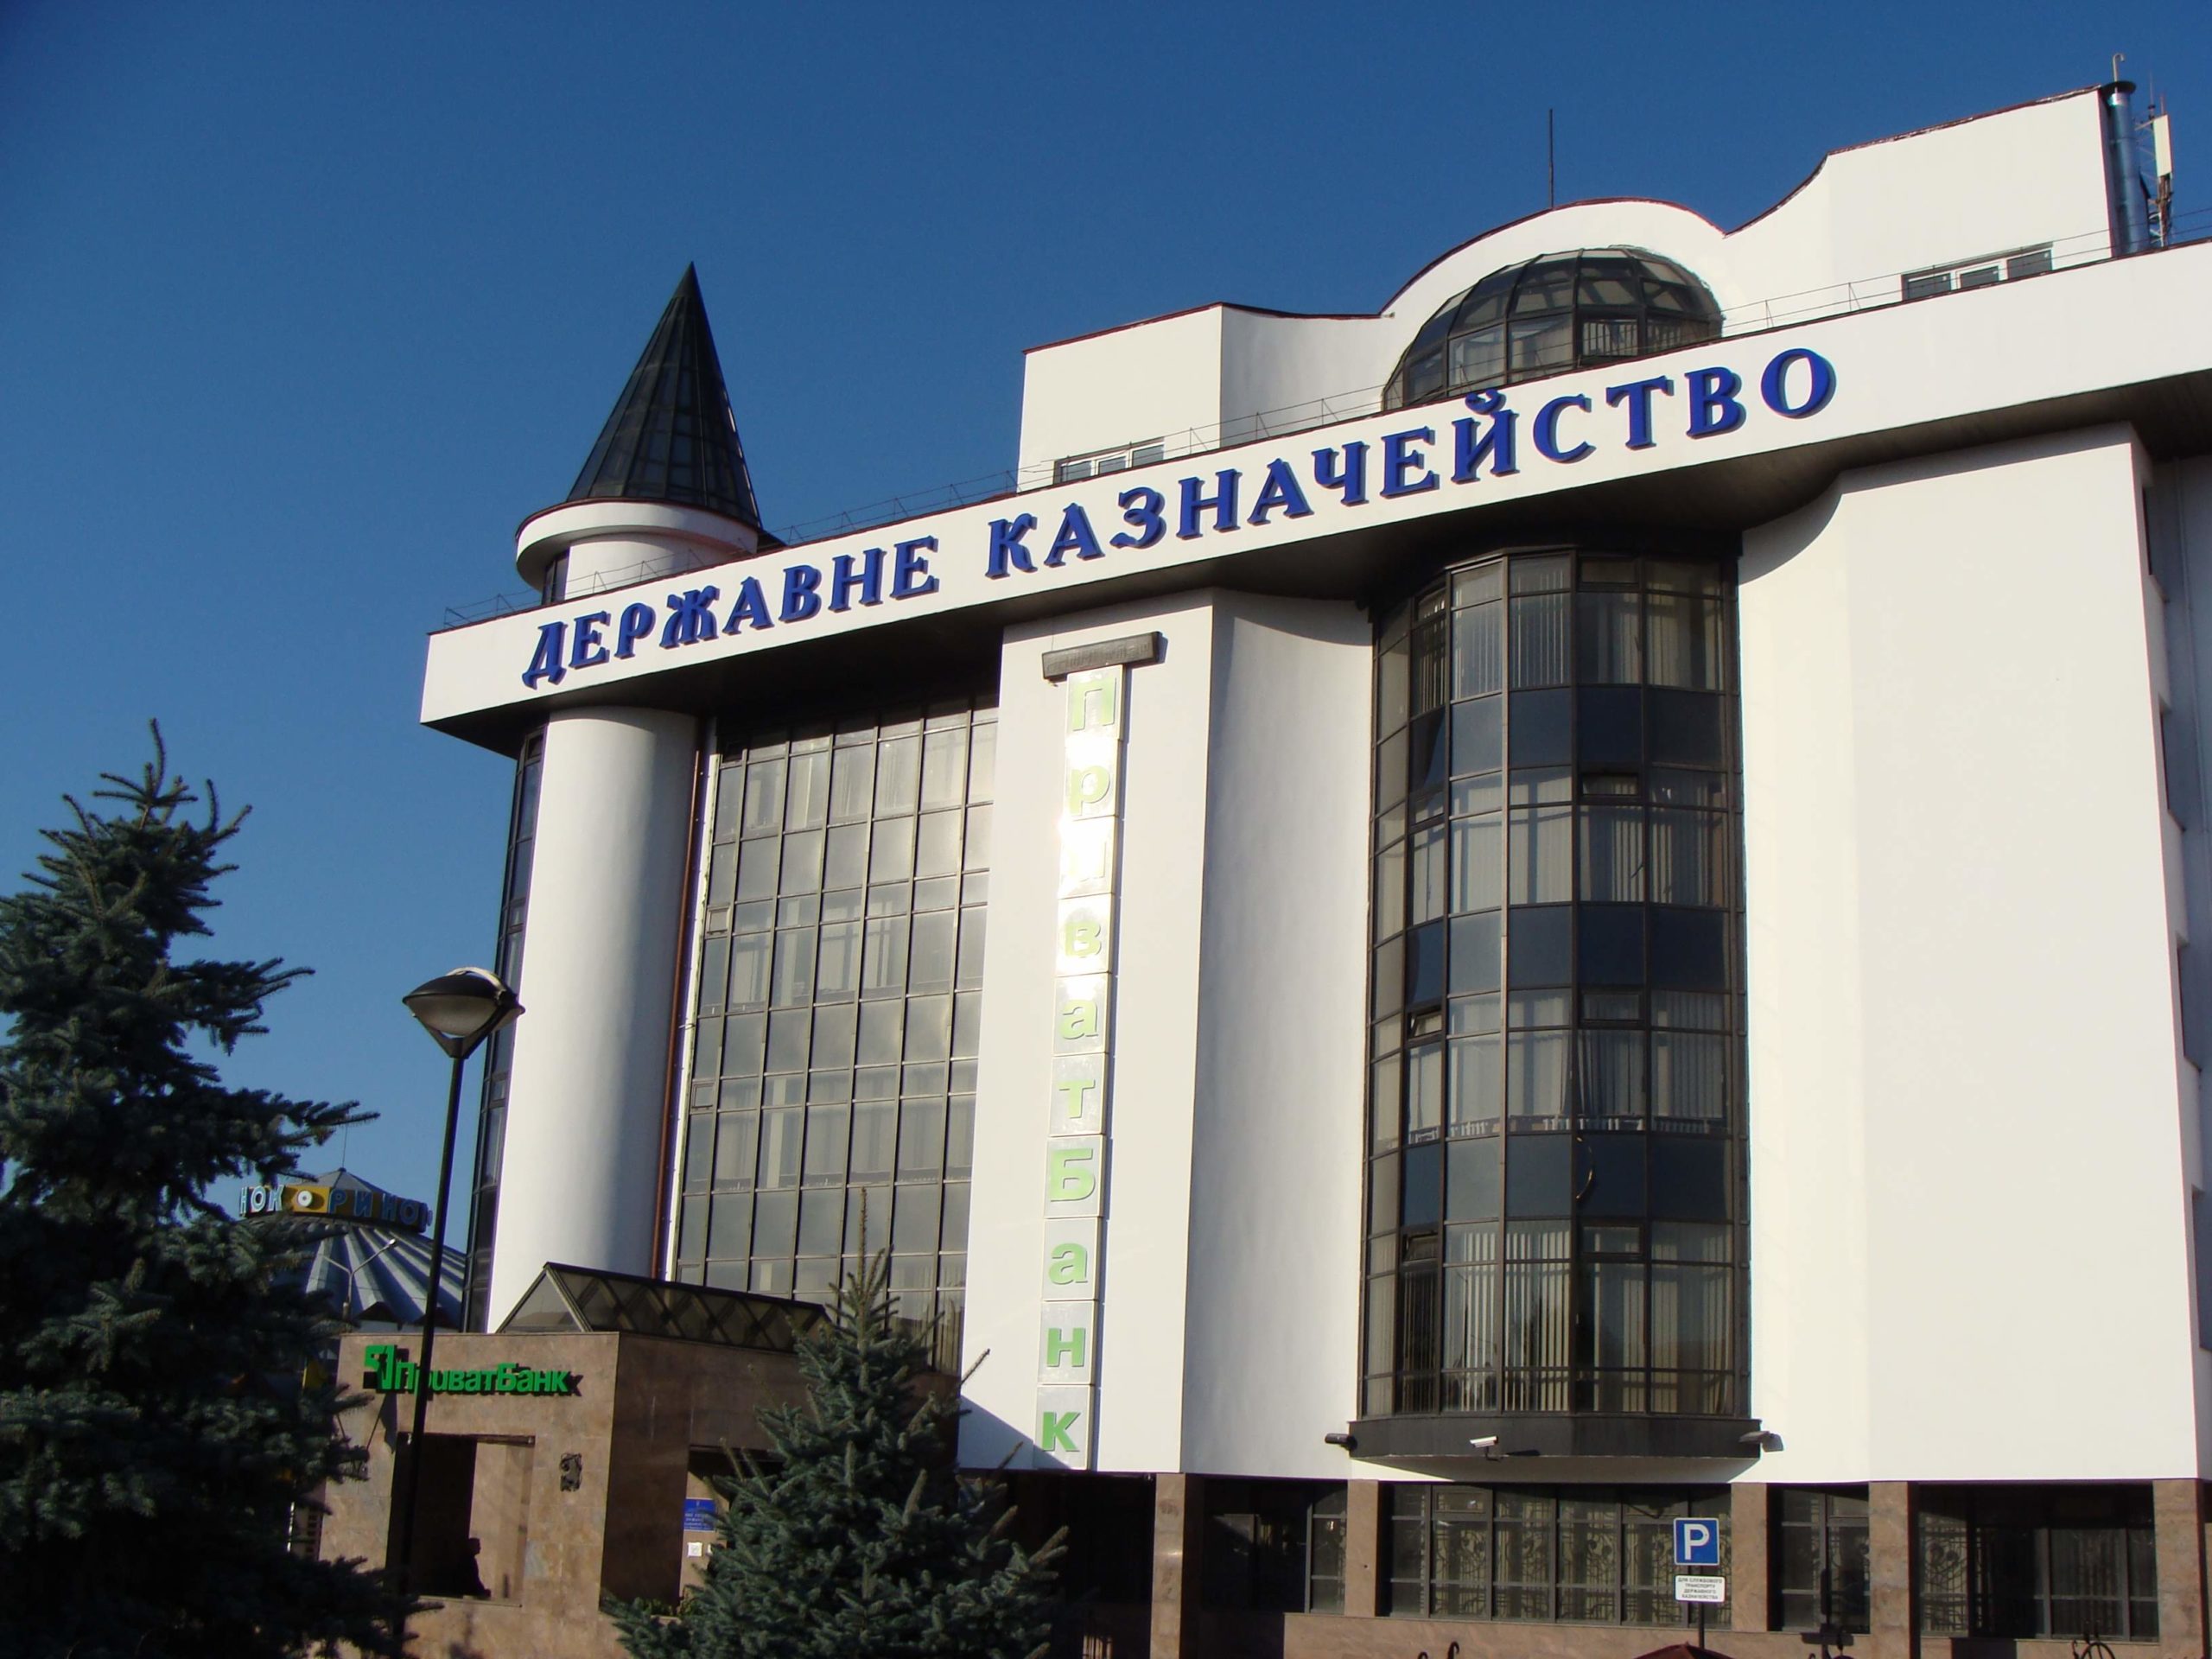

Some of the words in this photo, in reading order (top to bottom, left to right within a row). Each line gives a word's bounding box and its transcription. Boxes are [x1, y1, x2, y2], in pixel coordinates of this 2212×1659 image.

[522, 536, 938, 689] ДЕРЖАВНЕ
[986, 348, 1835, 579] КАЗНАЧЕЙСТВО
[1684, 1523, 1710, 1560] P
